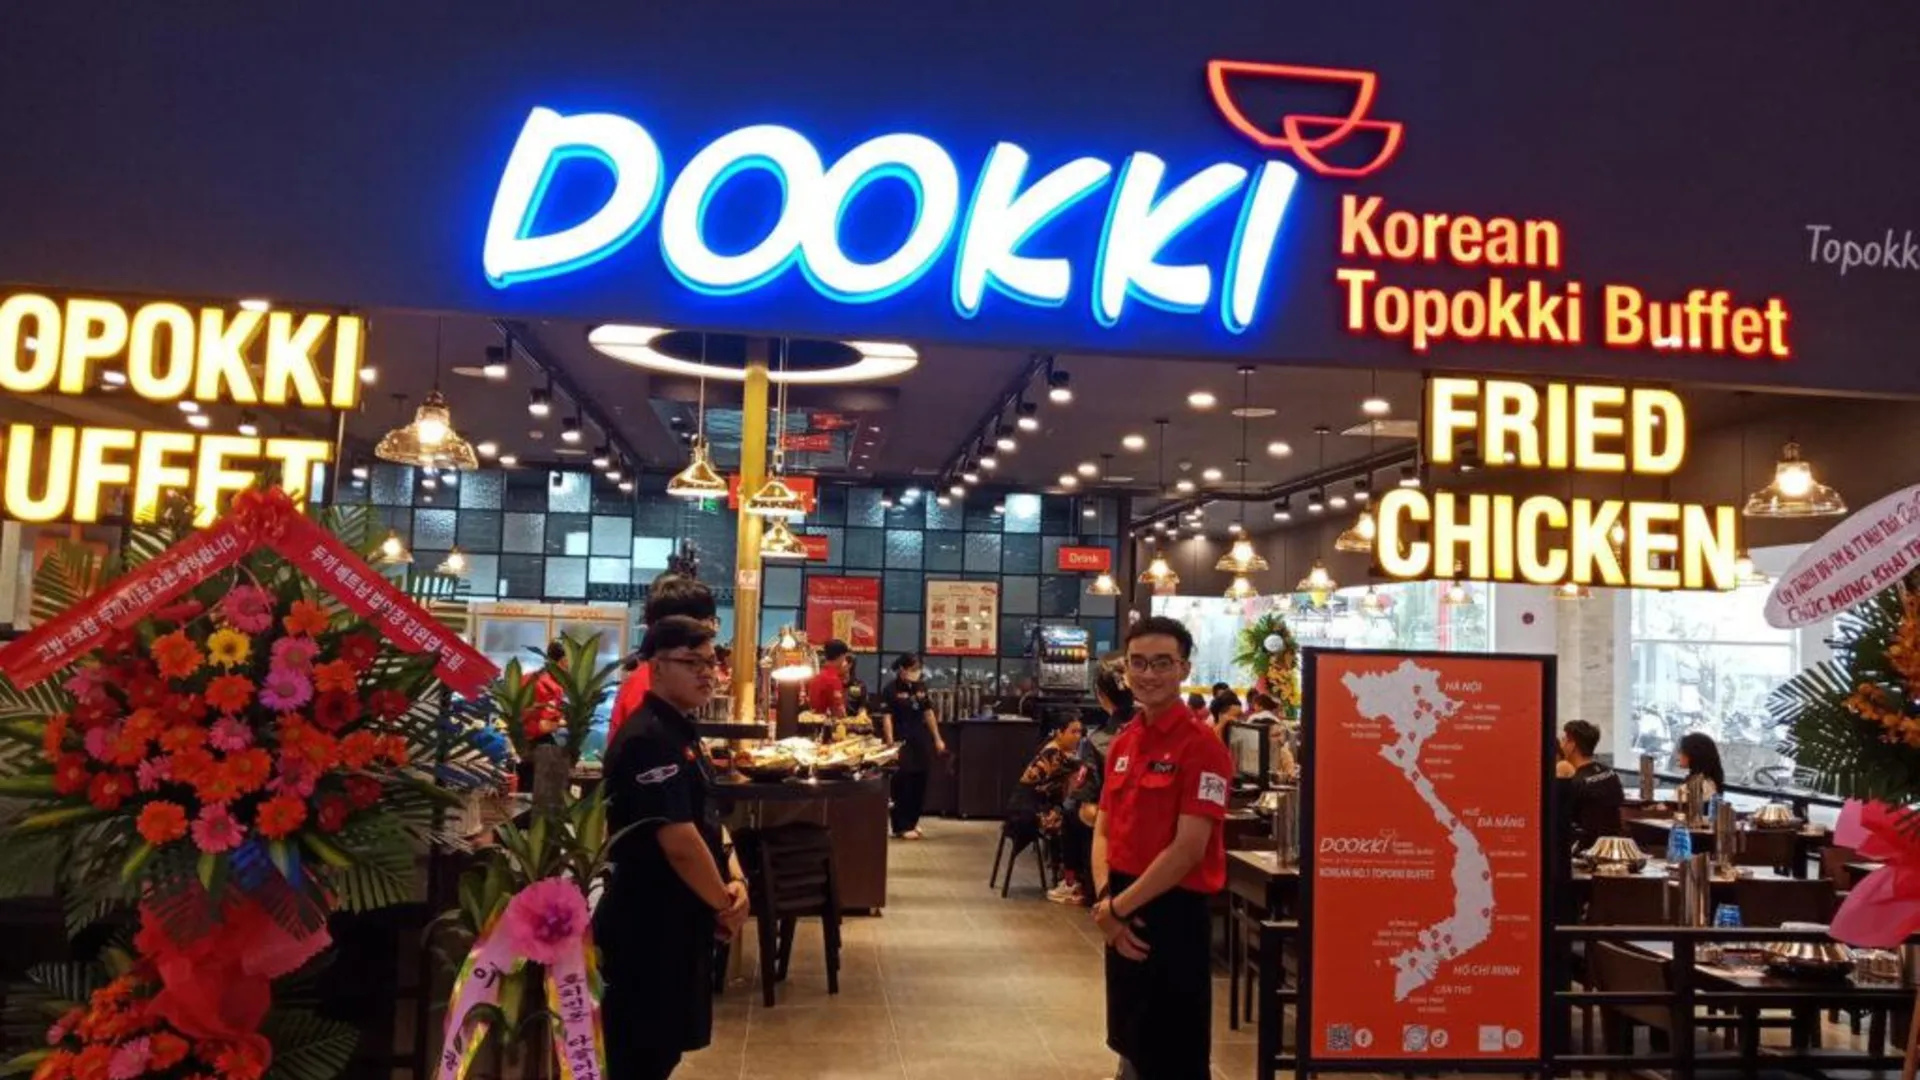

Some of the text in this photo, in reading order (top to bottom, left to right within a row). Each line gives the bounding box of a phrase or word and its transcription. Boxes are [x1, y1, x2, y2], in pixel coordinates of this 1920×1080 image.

[484, 106, 1299, 333] DOOKKI
[1341, 195, 1560, 268] Korean
[1806, 224, 1920, 276] Topokk
[0, 294, 361, 409] OPOKKI
[1337, 268, 1789, 356] Topokki Buffet
[1429, 376, 1686, 474] FRIED
[1069, 552, 1099, 564] Drink
[1377, 489, 1736, 590] CHICKEN
[1320, 837, 1391, 853] DOOKKI
